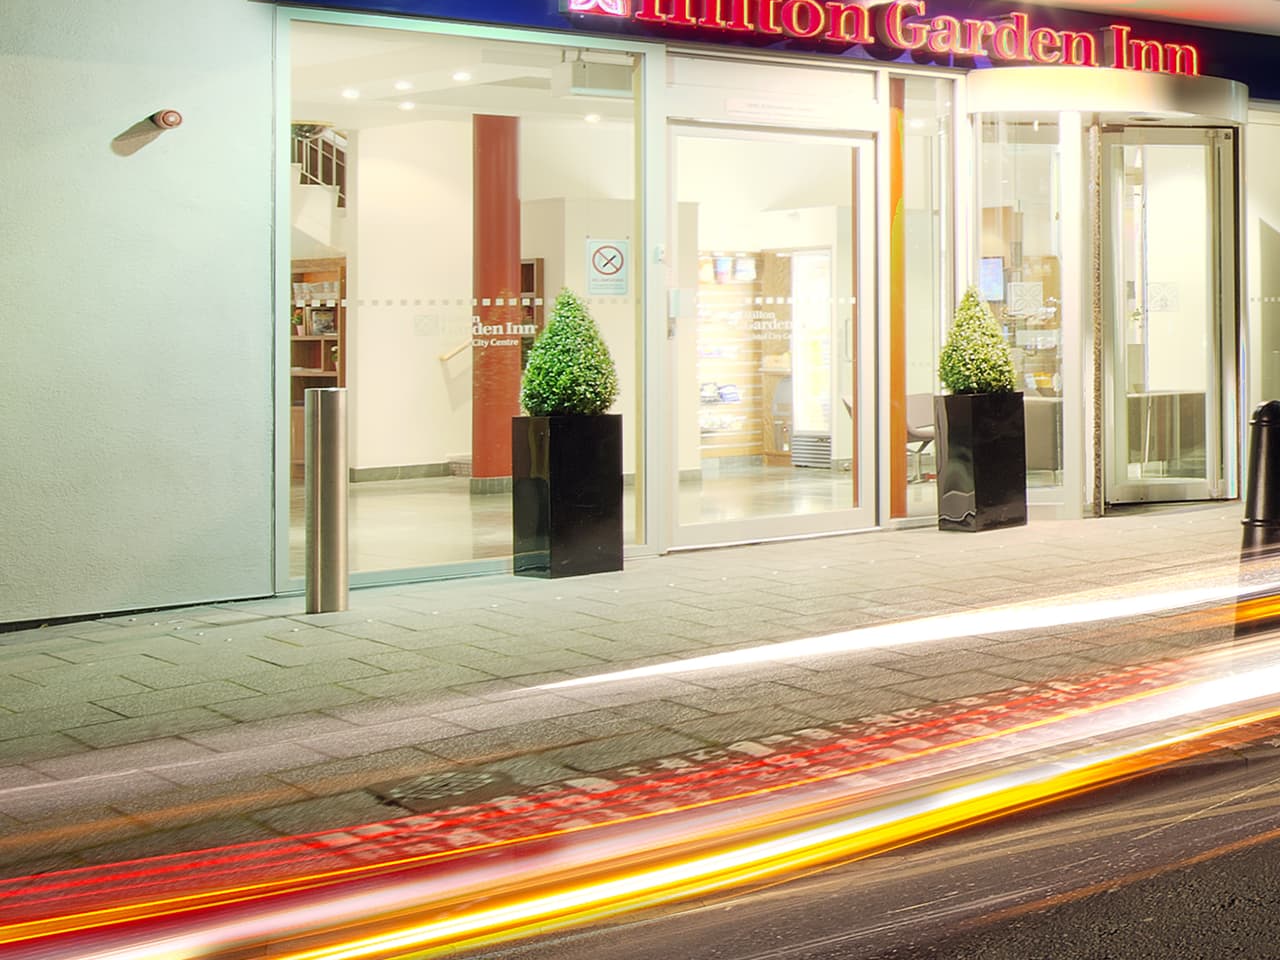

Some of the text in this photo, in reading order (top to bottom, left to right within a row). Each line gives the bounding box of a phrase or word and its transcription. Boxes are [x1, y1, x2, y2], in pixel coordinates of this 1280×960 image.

[1109, 24, 1200, 77] Inn
[472, 321, 538, 336] den Inn
